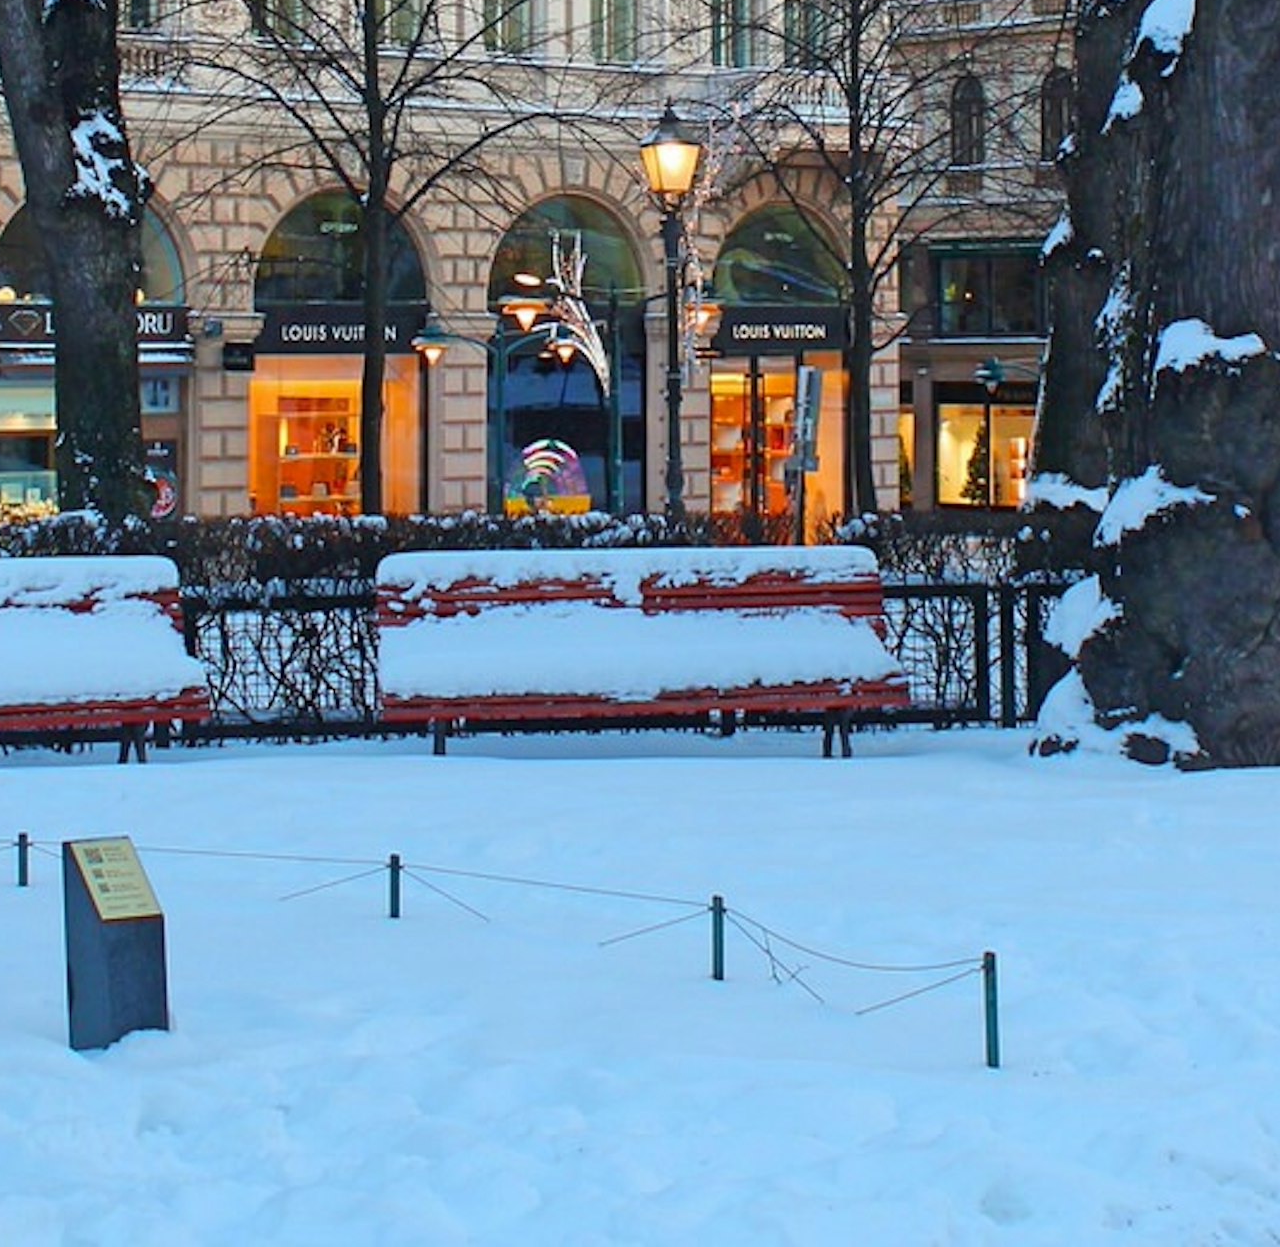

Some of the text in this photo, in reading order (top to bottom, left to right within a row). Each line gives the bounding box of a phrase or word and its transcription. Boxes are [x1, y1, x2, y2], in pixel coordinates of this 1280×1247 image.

[281, 324, 397, 341] LOUIS VUITN
[732, 324, 826, 339] LOUIS VUITTON
